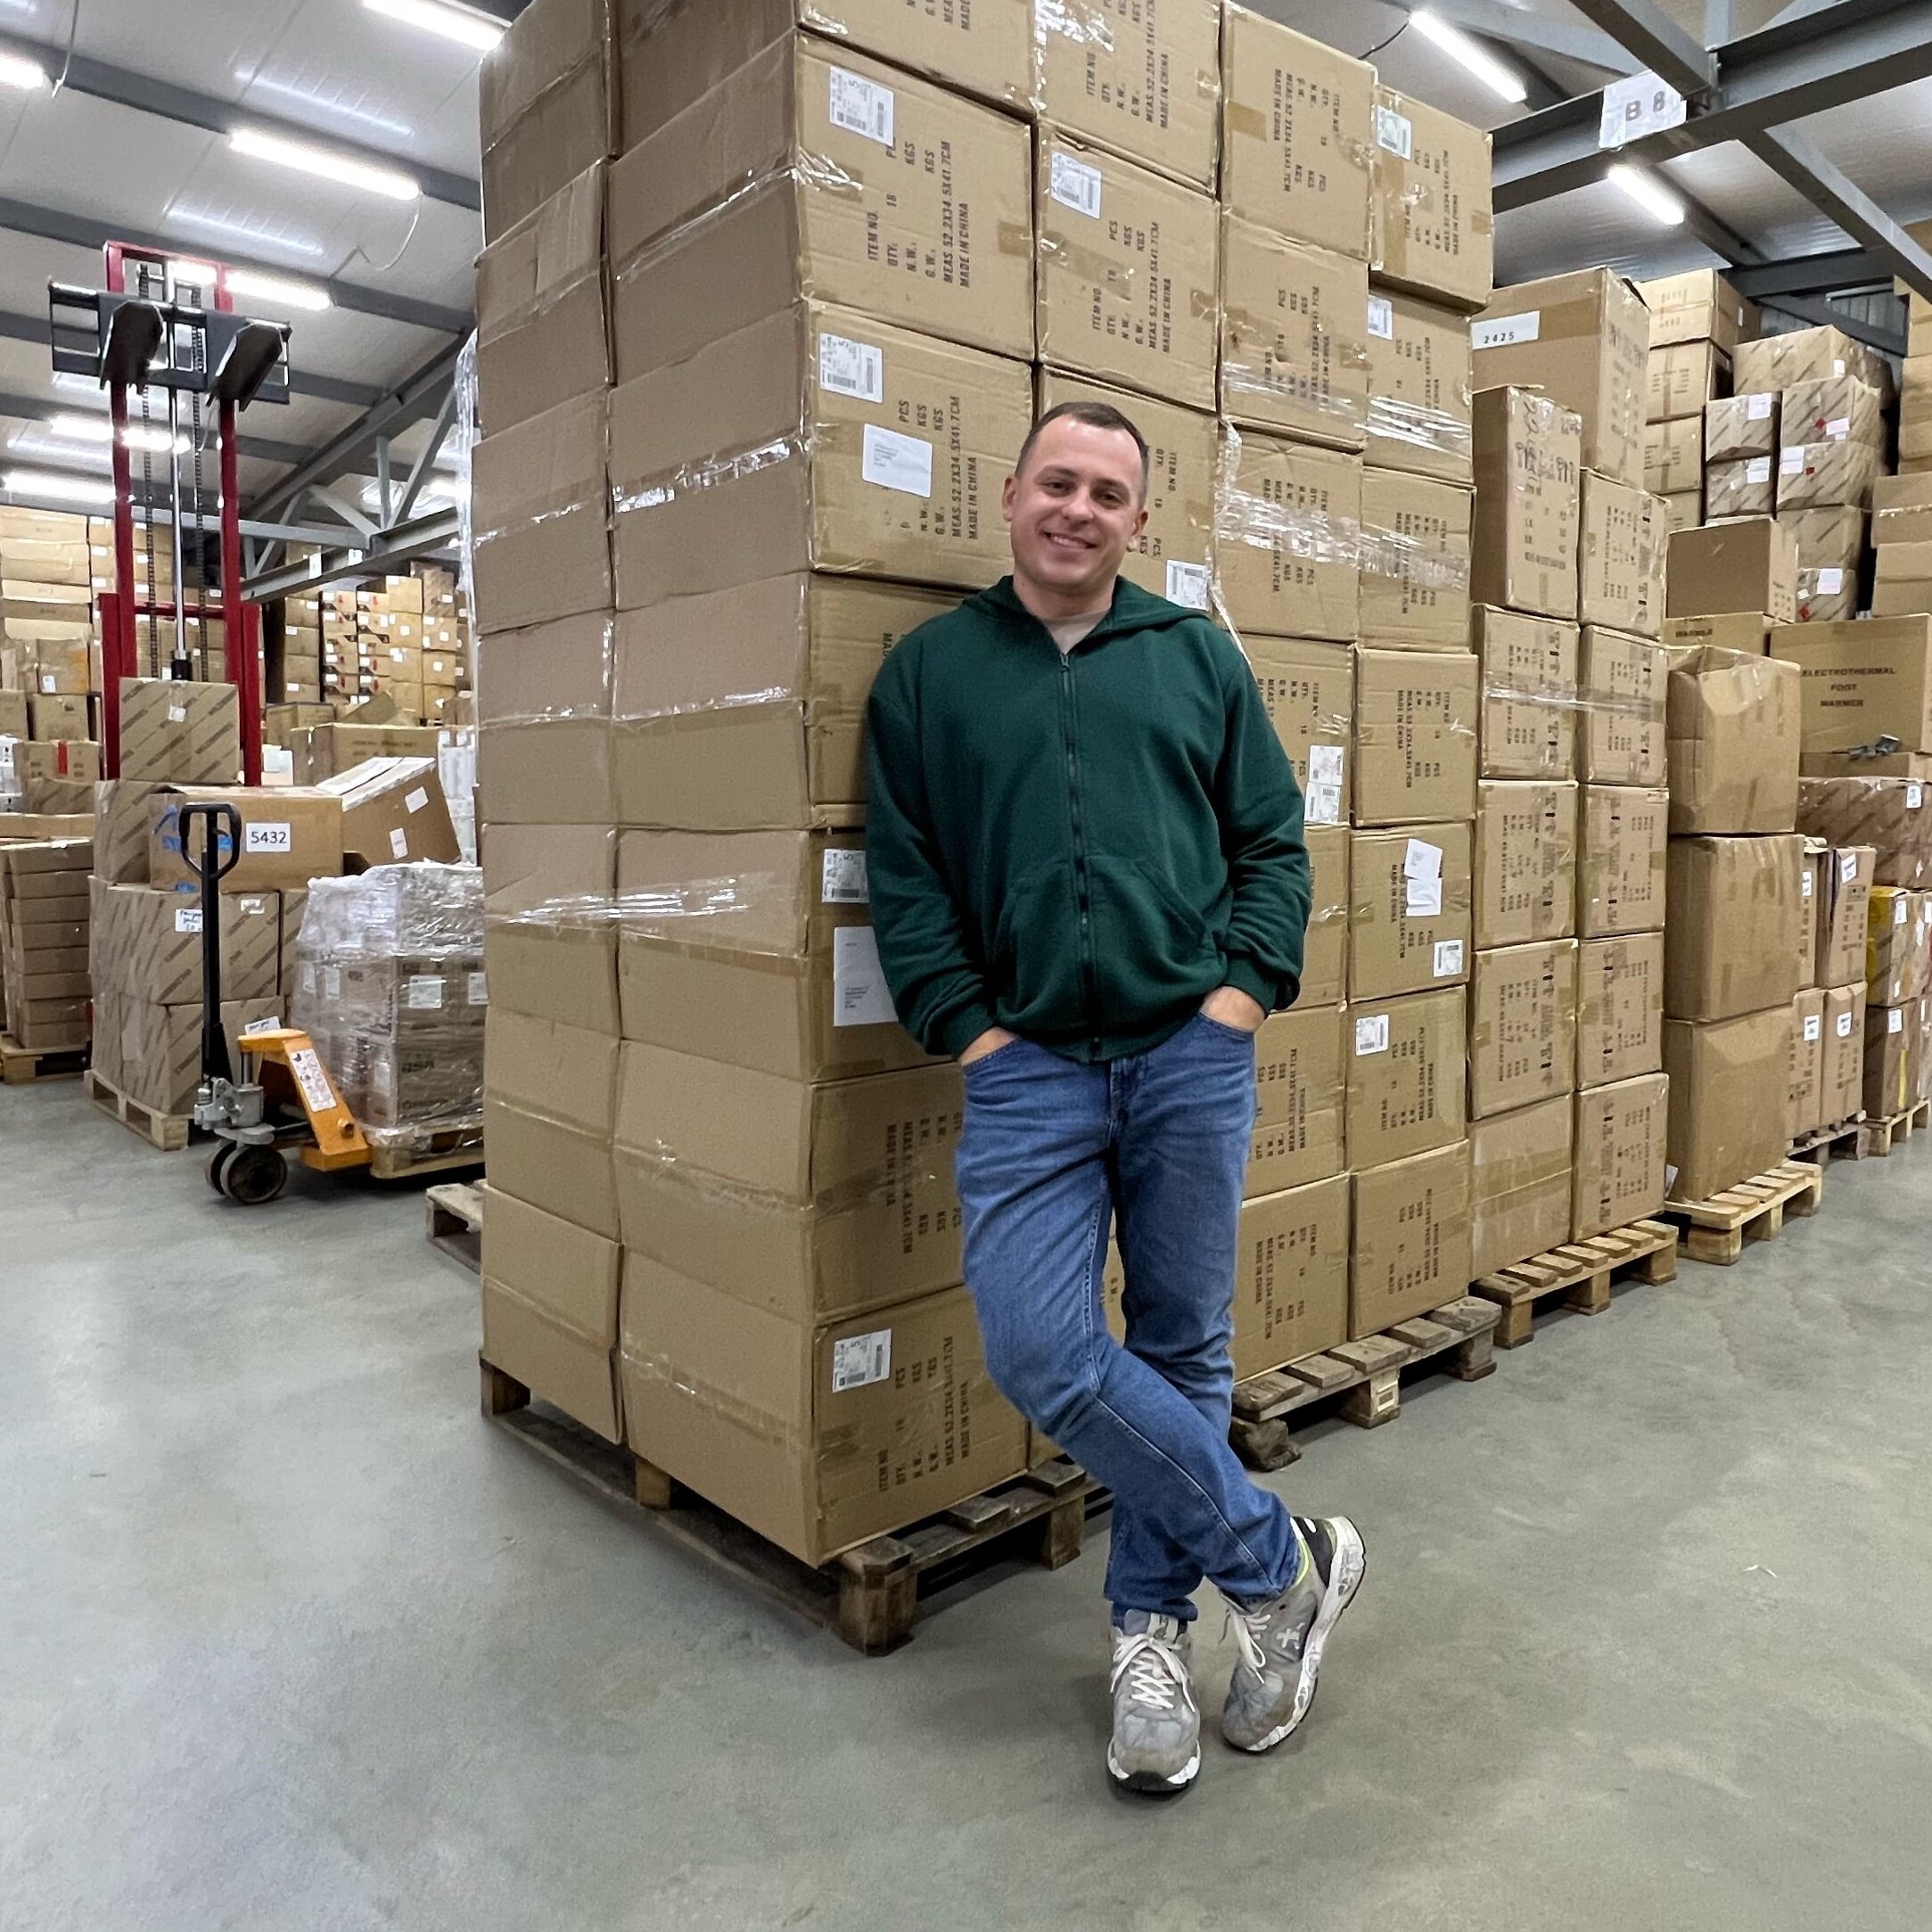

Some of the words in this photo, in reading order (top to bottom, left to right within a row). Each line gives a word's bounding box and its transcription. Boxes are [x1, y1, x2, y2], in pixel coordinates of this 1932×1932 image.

[1625, 100, 1642, 121] B
[1653, 91, 1665, 113] 8
[905, 142, 916, 166] KGS
[925, 150, 935, 174] KGS
[958, 202, 969, 238] CHINA
[1109, 220, 1118, 242] PCS
[867, 232, 878, 261] ITEM
[1123, 226, 1132, 247] KGS
[1137, 230, 1145, 252] KGS
[960, 243, 969, 256] IN
[960, 258, 969, 288] MADE
[1163, 278, 1172, 310] CHINA
[1092, 305, 1101, 331] ITEM
[1163, 325, 1171, 354] MADE
[899, 399, 909, 423] PCS
[917, 404, 927, 428] KGS
[933, 408, 943, 432] KGS
[967, 456, 977, 491] CHINA
[969, 493, 977, 507] IN
[968, 509, 978, 539] MADE
[1801, 667, 1896, 678] ELECTROTHERMAL
[1830, 684, 1857, 692] FOOT
[1821, 699, 1864, 708] WARMER
[251, 831, 287, 844] 5432
